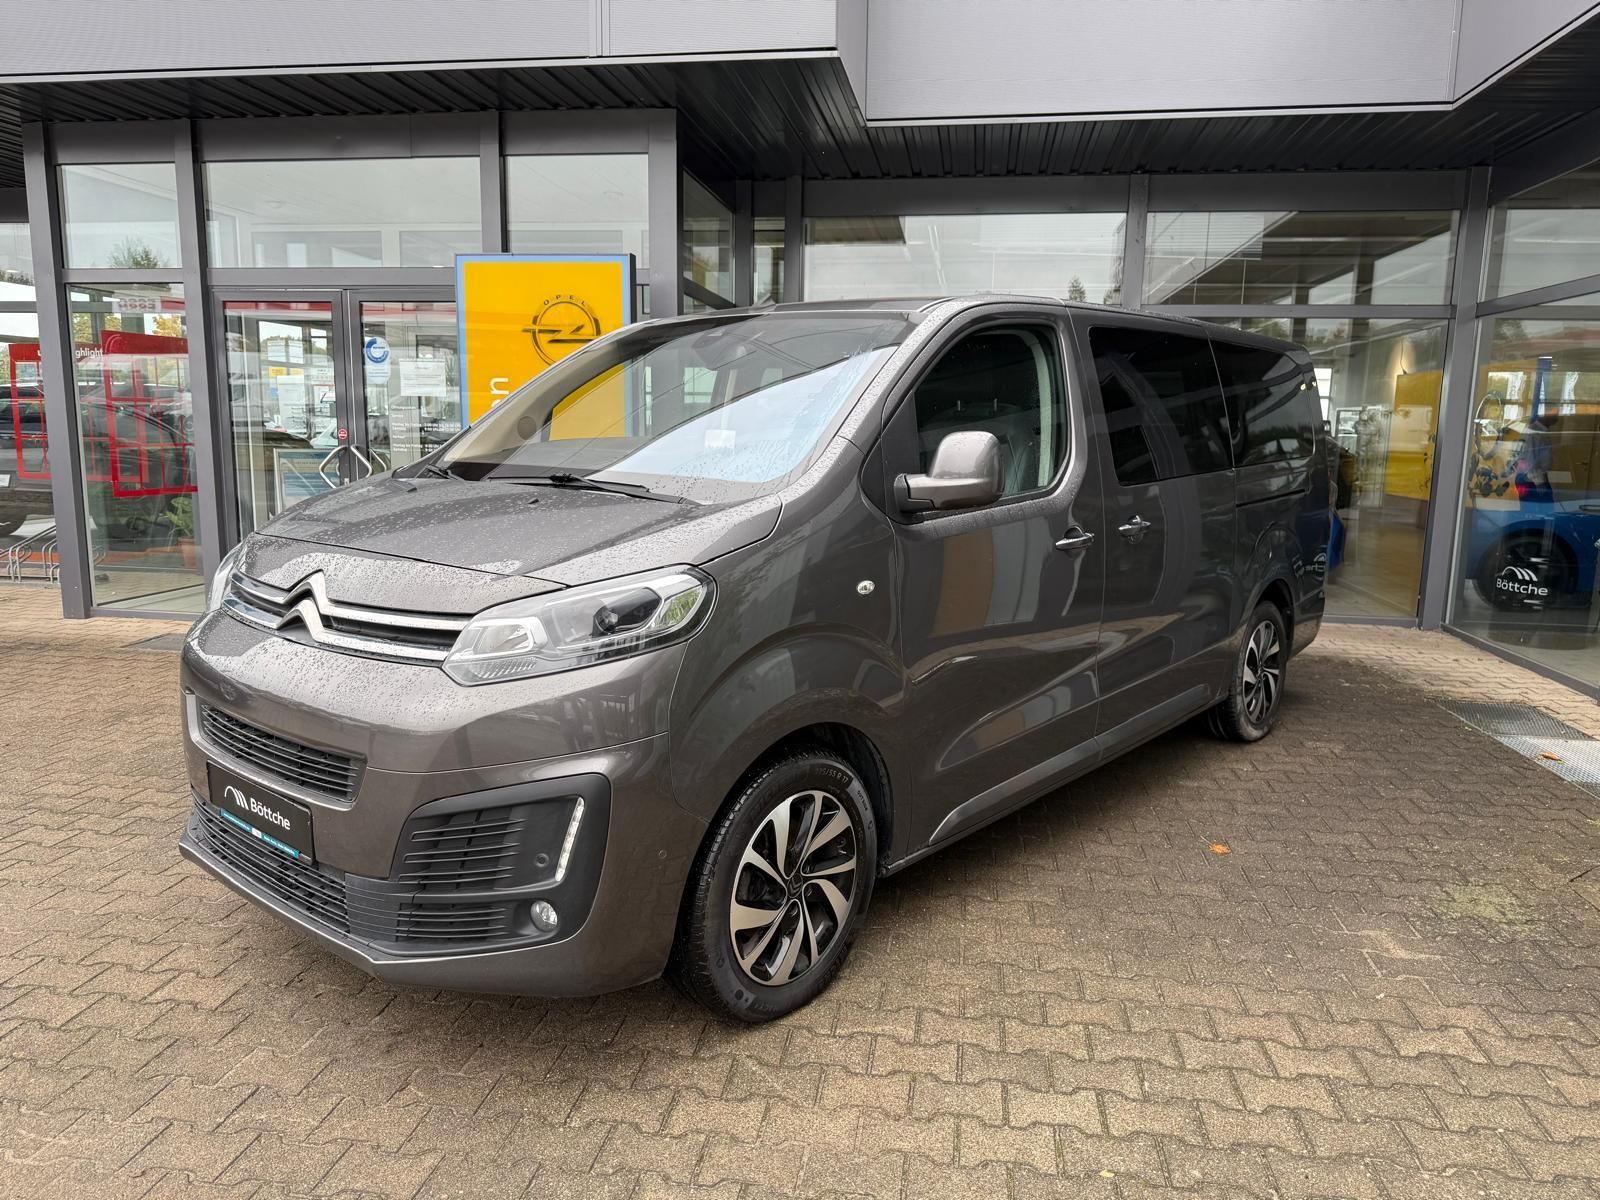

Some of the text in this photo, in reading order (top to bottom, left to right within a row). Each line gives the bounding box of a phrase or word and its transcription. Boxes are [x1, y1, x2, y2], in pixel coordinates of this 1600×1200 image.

[543, 294, 586, 306] OPEL
[74, 347, 104, 358] ghlight
[1496, 578, 1548, 596] Böttche
[250, 797, 291, 830] Böttche
